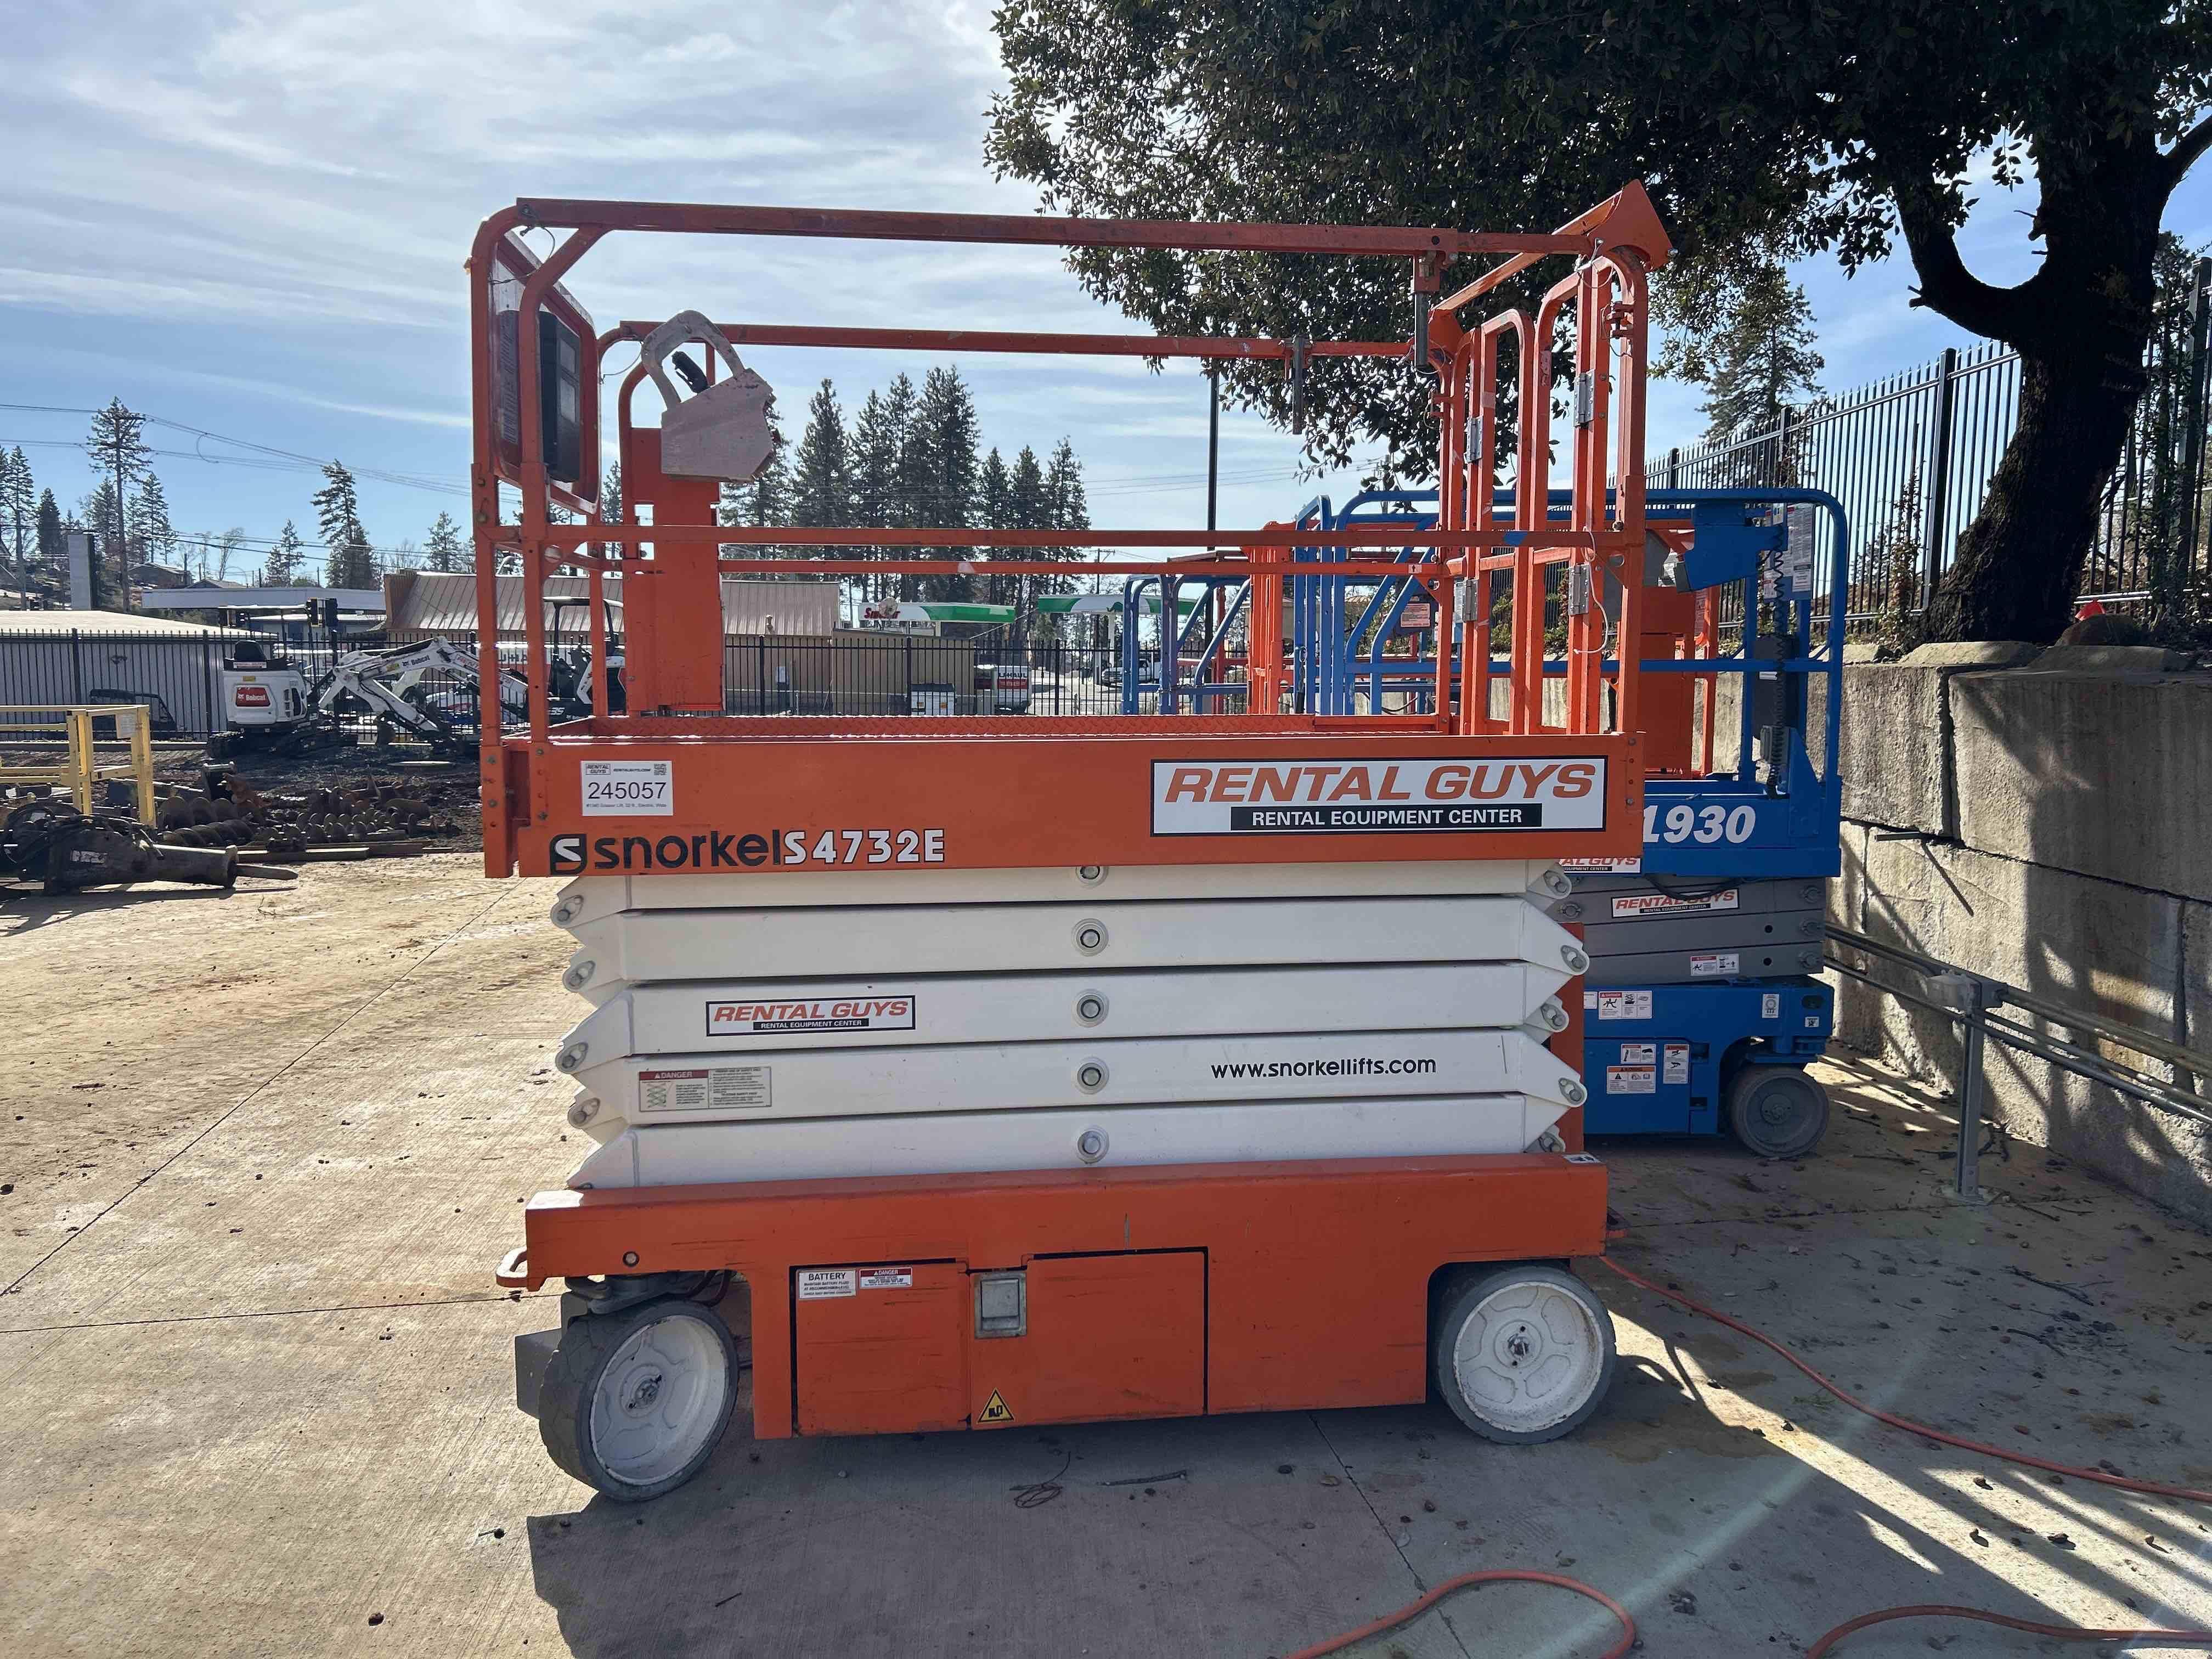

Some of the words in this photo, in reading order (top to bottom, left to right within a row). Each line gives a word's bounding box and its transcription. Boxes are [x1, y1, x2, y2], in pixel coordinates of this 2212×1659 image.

[411, 655, 430, 665] Bobcat
[588, 782, 667, 799] 245057
[1164, 766, 1412, 804] RENTAL
[1424, 763, 1596, 800] GUYS
[1251, 810, 1327, 826] RENTAL
[1330, 809, 1443, 826] EQUIPMENT
[1448, 808, 1522, 824] CENTER
[594, 829, 781, 870] snorkel
[782, 828, 945, 865] S4732E
[714, 1004, 826, 1022] RENTAL
[831, 1001, 909, 1018] GUYS
[1211, 1058, 1436, 1079] www.snorkellifts.com
[808, 1272, 847, 1281] BATTERY
